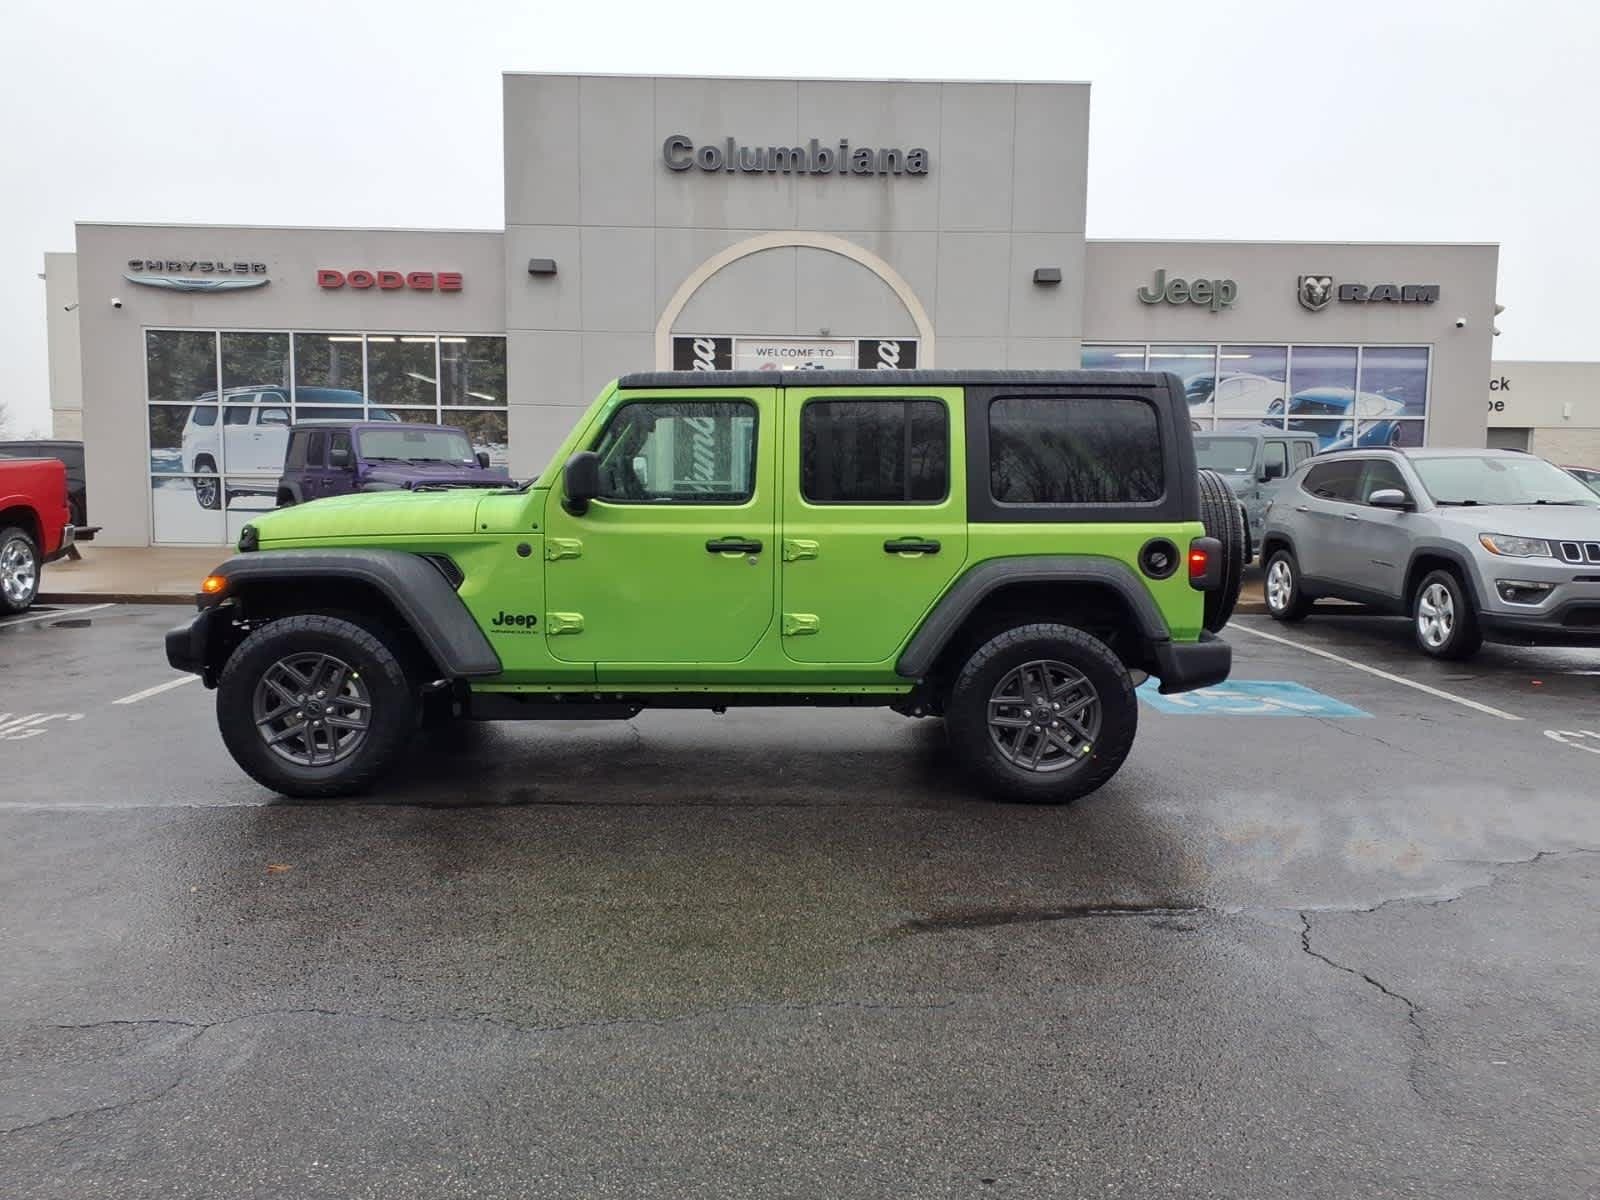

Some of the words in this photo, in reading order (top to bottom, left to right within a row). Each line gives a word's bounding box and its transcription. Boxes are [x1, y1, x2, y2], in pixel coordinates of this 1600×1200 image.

[663, 134, 929, 175] Columbiana
[128, 259, 267, 273] CHRYSLER
[317, 269, 463, 291] DODGE
[1138, 268, 1238, 313] Jeep
[1338, 283, 1441, 304] RAM
[756, 348, 813, 358] WELCOME
[819, 349, 834, 358] TO
[491, 610, 537, 629] Jeep
